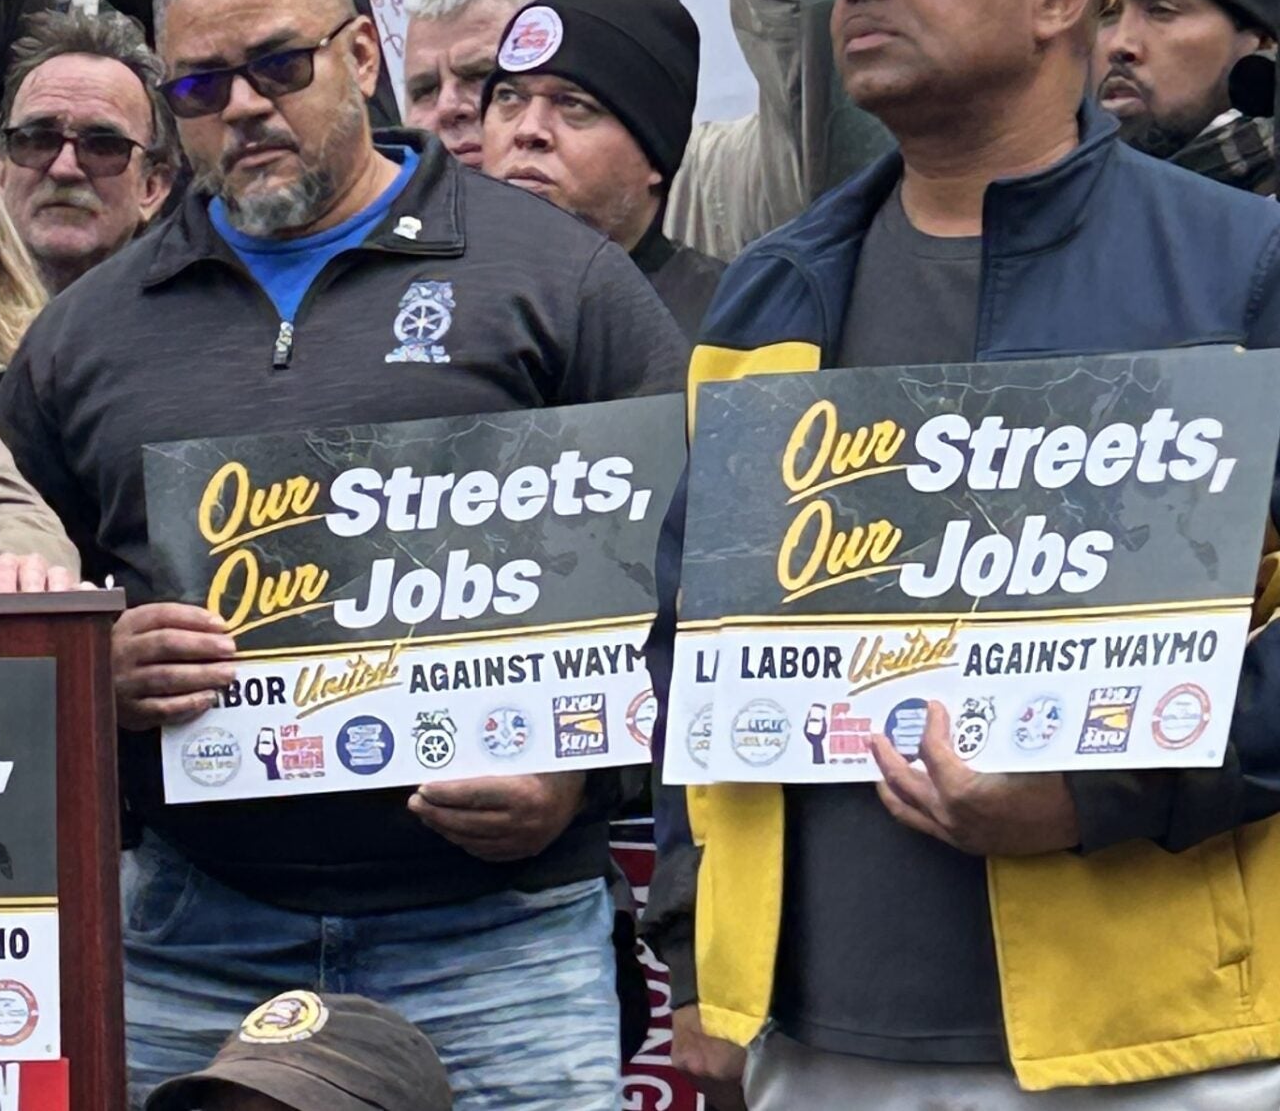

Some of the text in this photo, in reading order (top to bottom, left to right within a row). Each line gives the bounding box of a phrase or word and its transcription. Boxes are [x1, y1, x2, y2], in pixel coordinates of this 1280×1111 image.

[781, 399, 1238, 500] Our Streets,
[197, 450, 651, 548] Our Streets,
[206, 548, 542, 634] Our Jobs
[777, 499, 1114, 599] Our Jobs
[218, 676, 286, 708] BOR
[409, 653, 545, 695] AGAINST
[552, 643, 646, 679] WAYM
[741, 646, 842, 679] LABOR
[963, 637, 1096, 677] AGAINST
[1104, 629, 1218, 670] WAYMO
